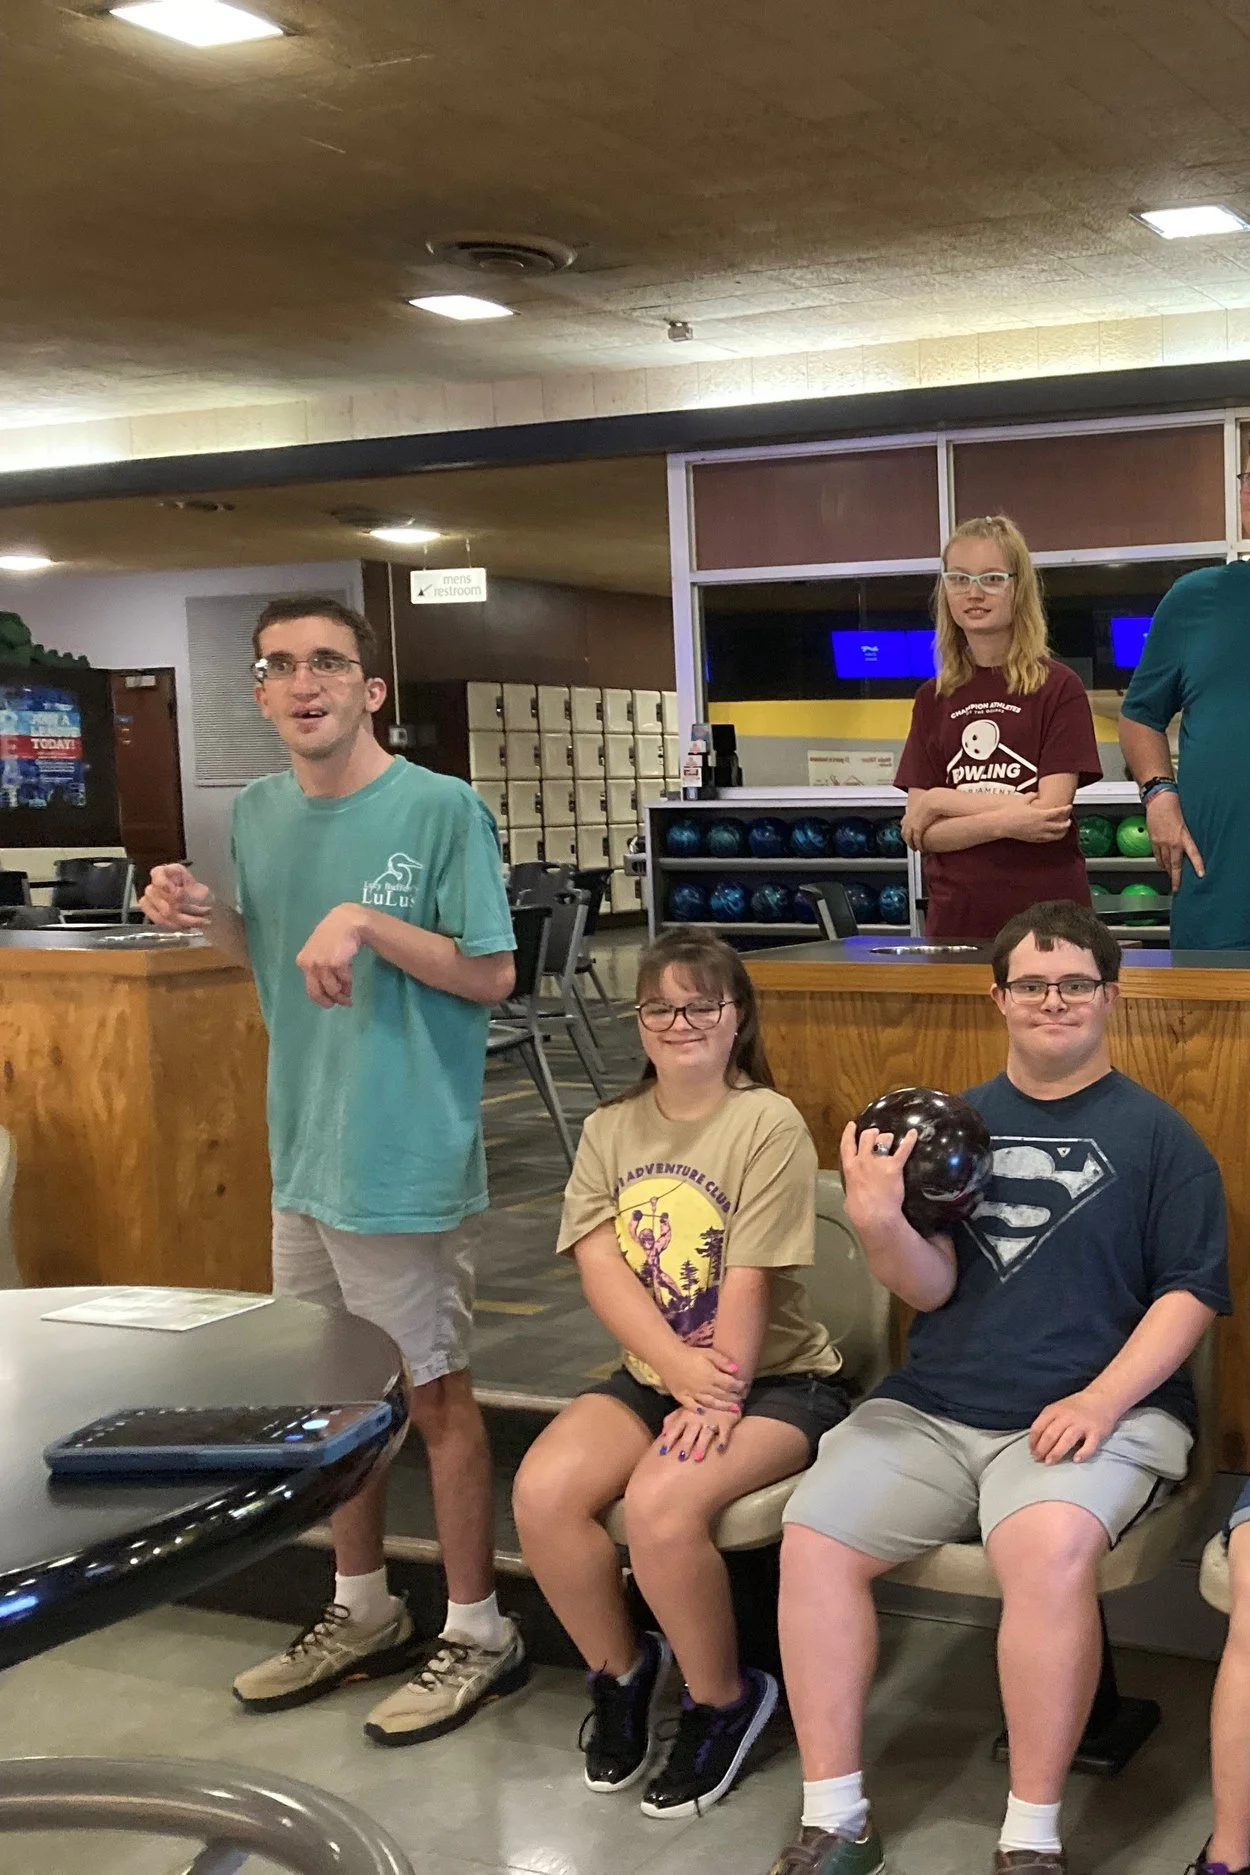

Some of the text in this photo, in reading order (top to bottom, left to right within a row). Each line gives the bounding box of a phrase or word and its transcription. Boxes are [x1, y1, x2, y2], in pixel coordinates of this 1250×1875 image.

[443, 575, 472, 585] mens
[434, 586, 482, 597] restroom
[950, 701, 1021, 719] CHAMPION ATHLETES
[31, 738, 76, 750] TODAY!
[626, 1163, 706, 1185] ADVENTURE
[704, 1181, 732, 1213] CLUB
